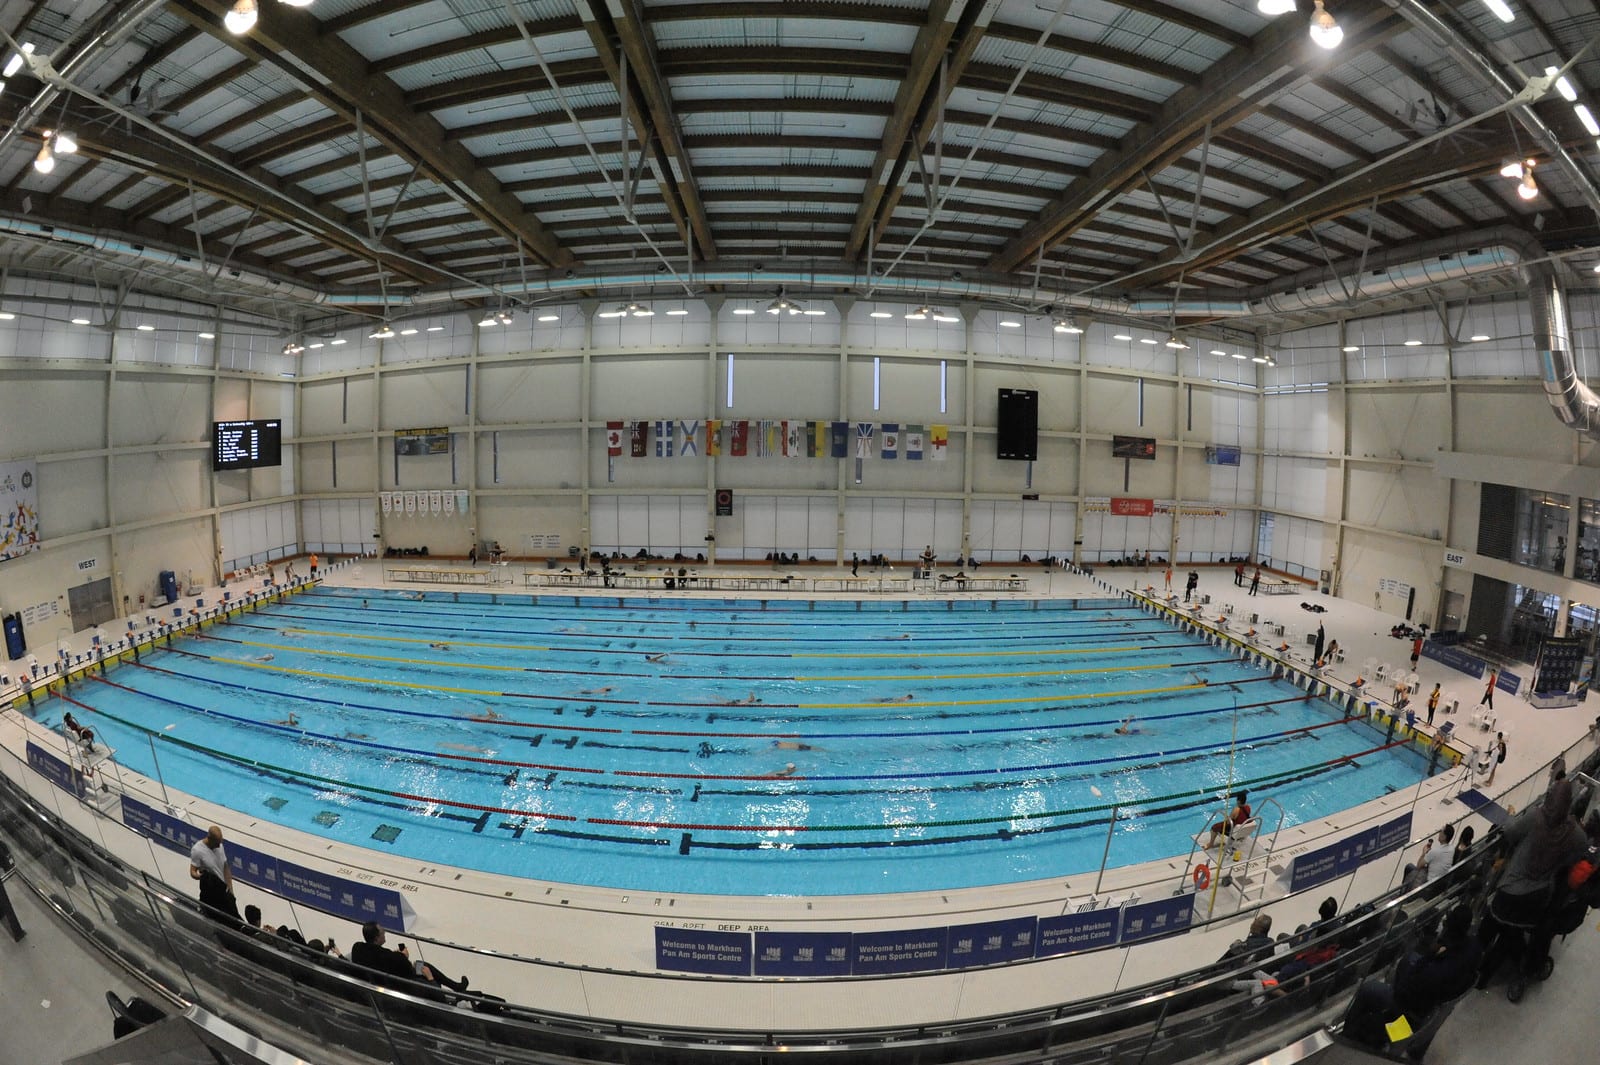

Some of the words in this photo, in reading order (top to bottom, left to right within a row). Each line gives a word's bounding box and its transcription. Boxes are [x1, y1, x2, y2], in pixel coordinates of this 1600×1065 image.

[79, 559, 96, 570] WEST
[1447, 553, 1463, 564] EAST
[380, 878, 398, 888] DEEP
[401, 884, 419, 893] AREA
[718, 924, 741, 932] DEEP
[1043, 928, 1073, 937] Welcome
[1082, 921, 1112, 932] Markham
[1042, 938, 1055, 947] Pan
[1056, 937, 1068, 945] Am
[1068, 935, 1090, 943] Sports
[1090, 930, 1111, 940] Centre
[662, 940, 696, 950] Welcome
[698, 943, 706, 951] to
[707, 943, 742, 953] Markham
[860, 945, 894, 953] Welcome
[904, 942, 938, 950] Markham
[662, 949, 677, 957] Pan
[678, 951, 691, 959] Am
[692, 951, 716, 962] Sports
[717, 953, 742, 962] Centre
[859, 954, 873, 962] Pan
[889, 952, 912, 961] Sports
[914, 951, 938, 959] Centre
